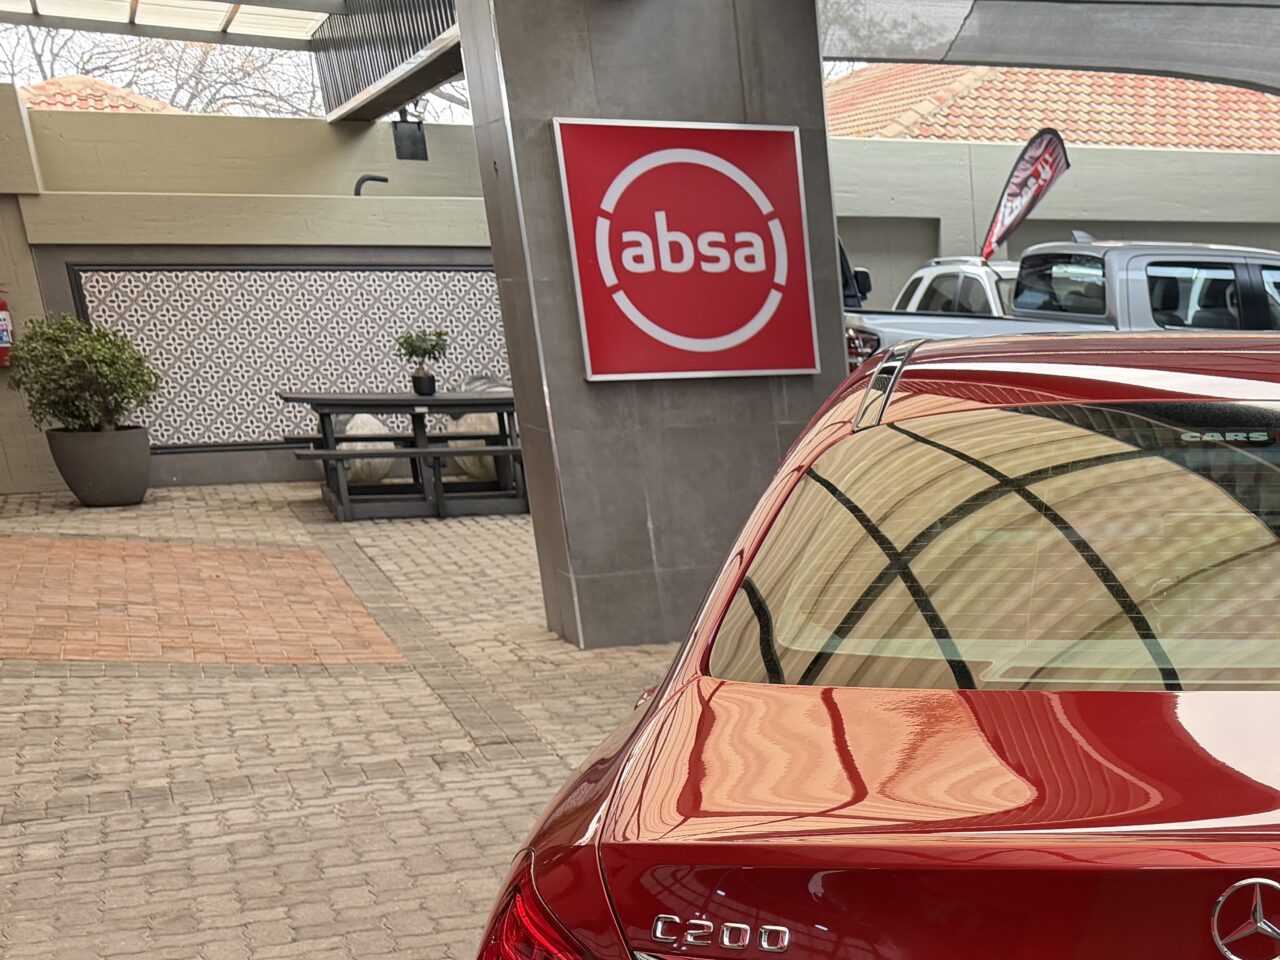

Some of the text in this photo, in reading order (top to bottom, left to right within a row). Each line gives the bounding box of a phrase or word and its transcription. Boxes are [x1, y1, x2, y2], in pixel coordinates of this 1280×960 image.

[621, 210, 767, 273] absa
[1180, 431, 1269, 442] CARS
[651, 913, 791, 953] C200
